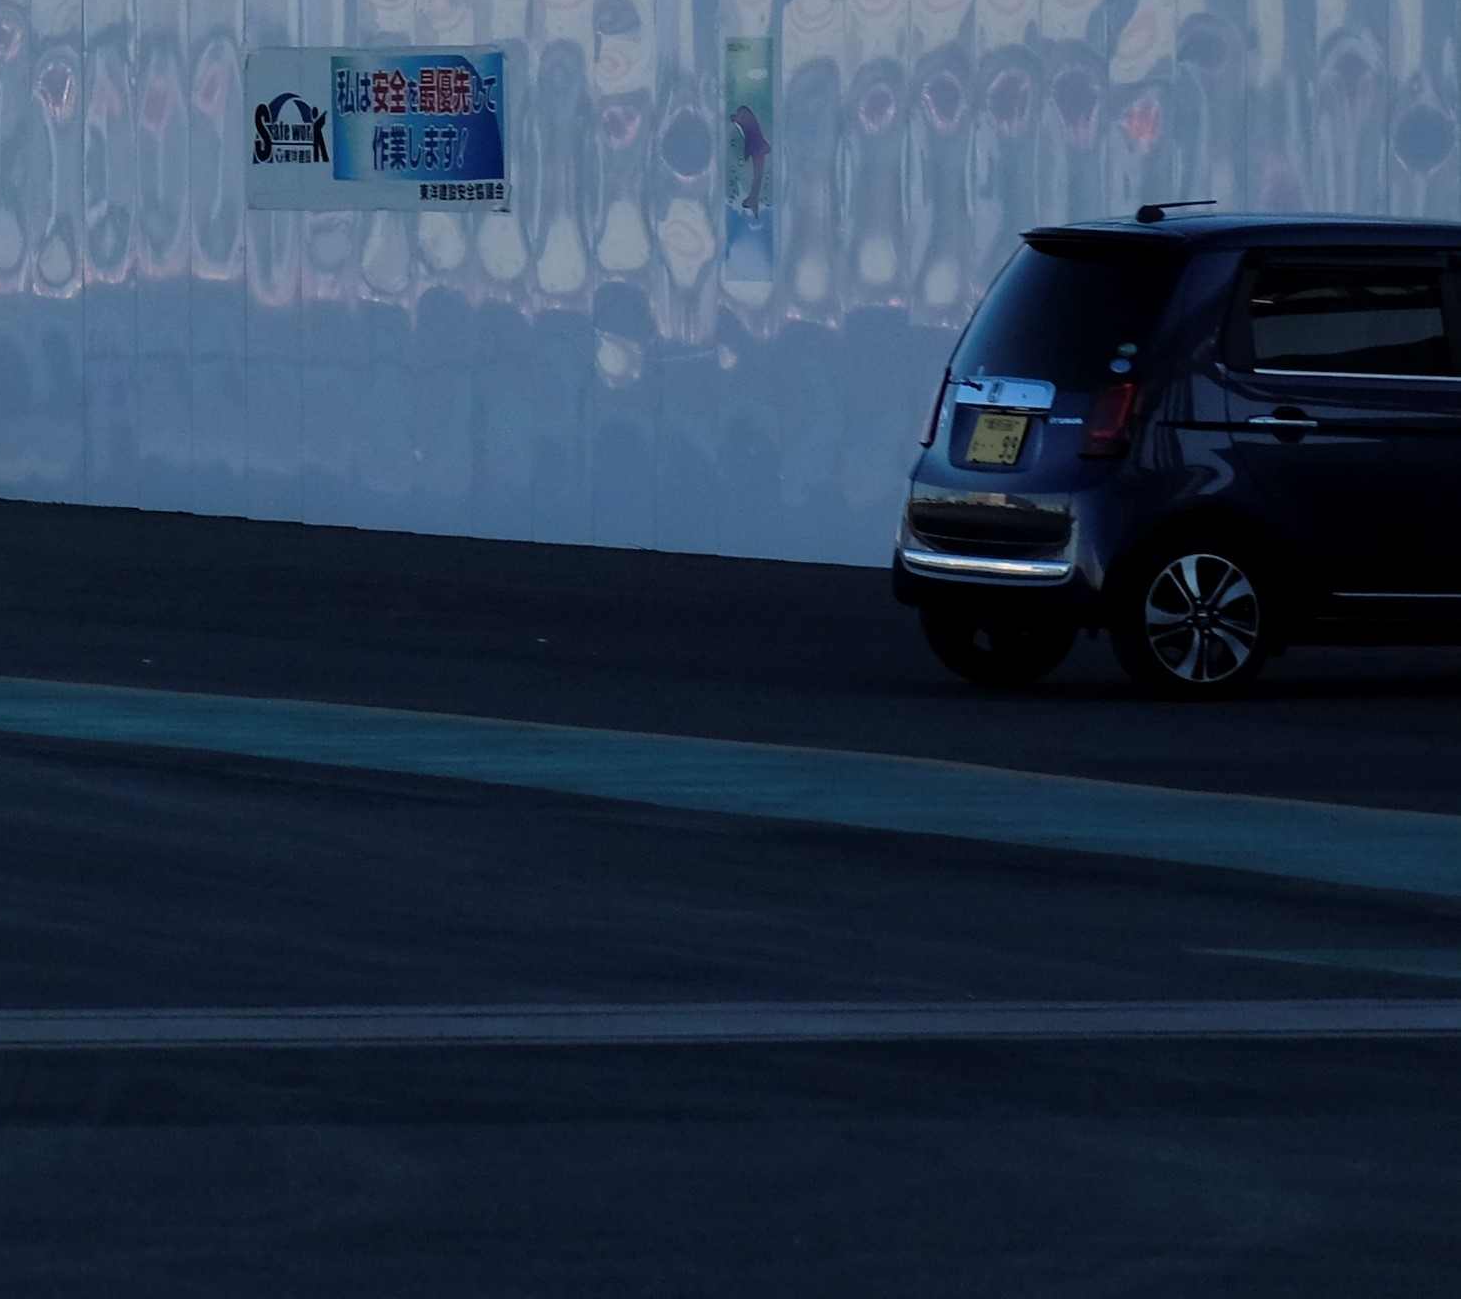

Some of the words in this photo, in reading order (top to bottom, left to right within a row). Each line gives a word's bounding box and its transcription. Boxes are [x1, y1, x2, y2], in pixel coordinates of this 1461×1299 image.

[336, 66, 498, 116] 私は安全を最優先して
